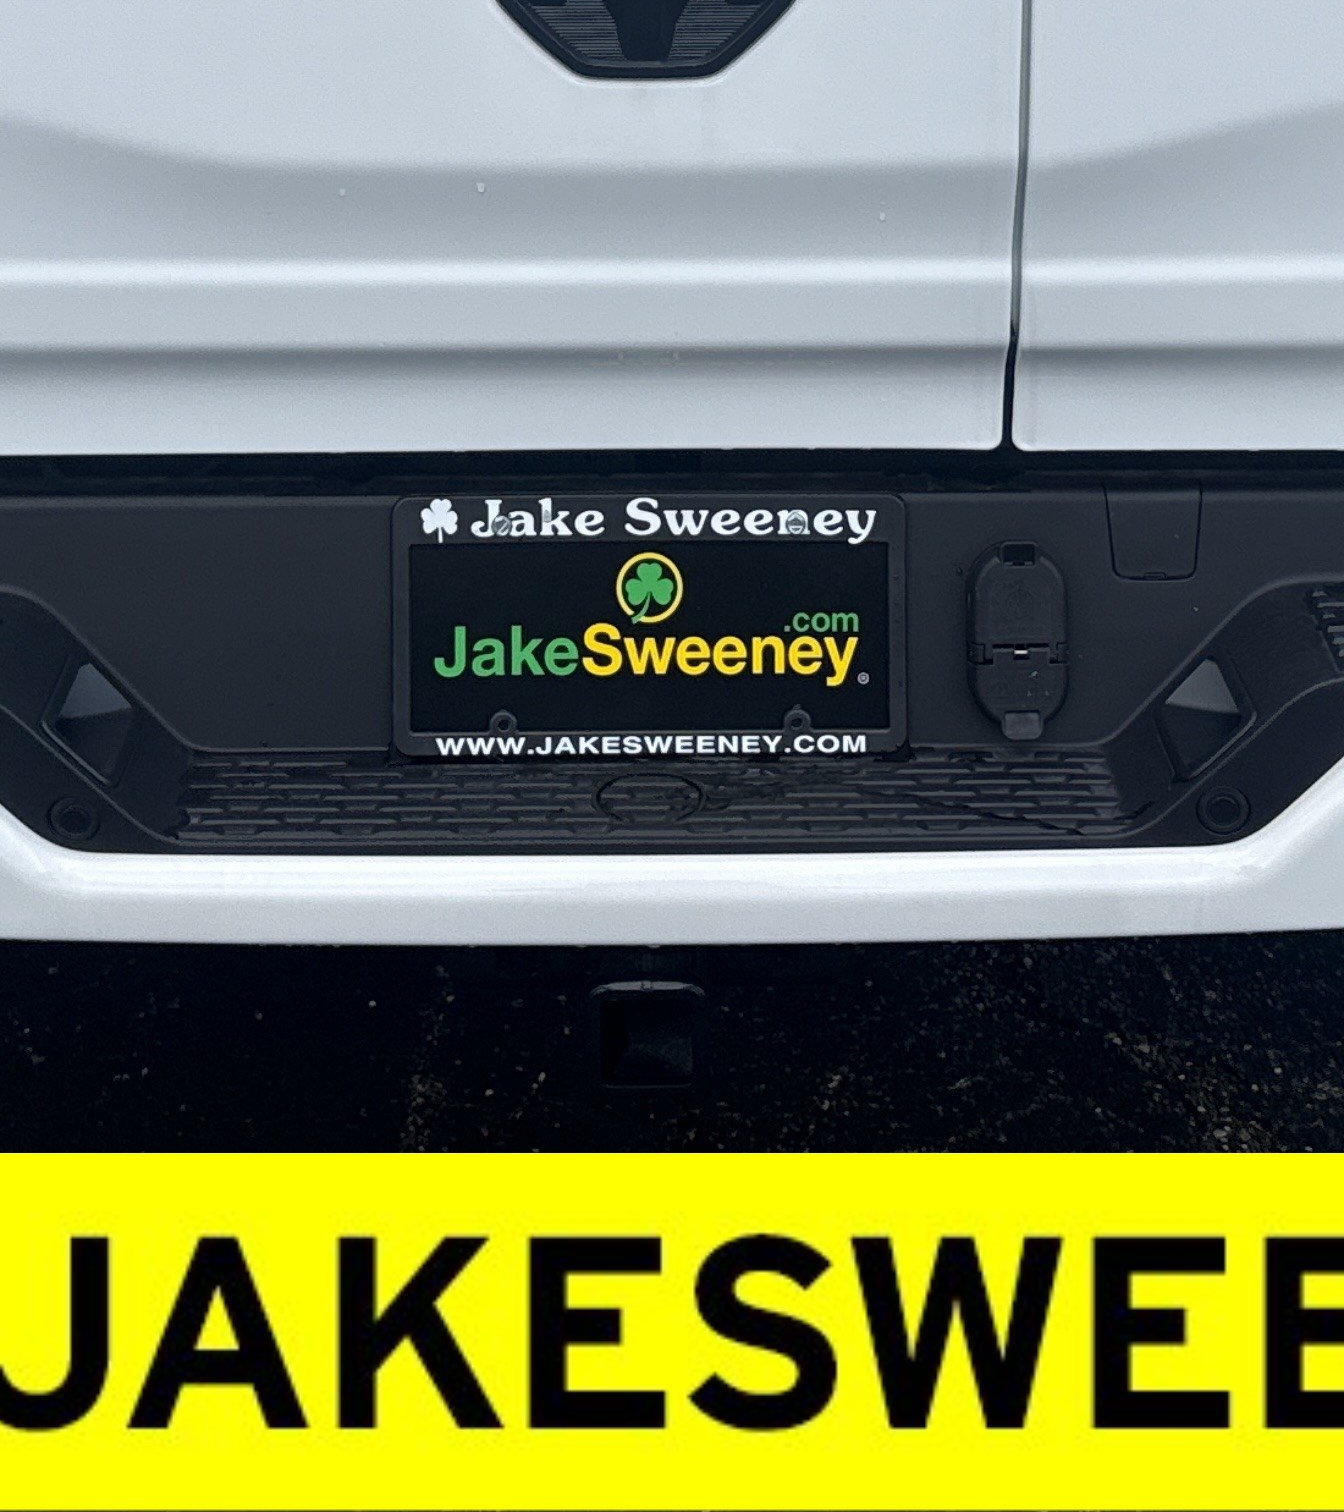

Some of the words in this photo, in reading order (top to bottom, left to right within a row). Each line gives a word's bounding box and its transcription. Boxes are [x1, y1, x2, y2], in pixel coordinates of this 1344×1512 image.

[470, 498, 605, 538] Jake
[625, 497, 877, 545] Sweeney
[435, 734, 867, 756] WWW.JAKESWEENEY.COM
